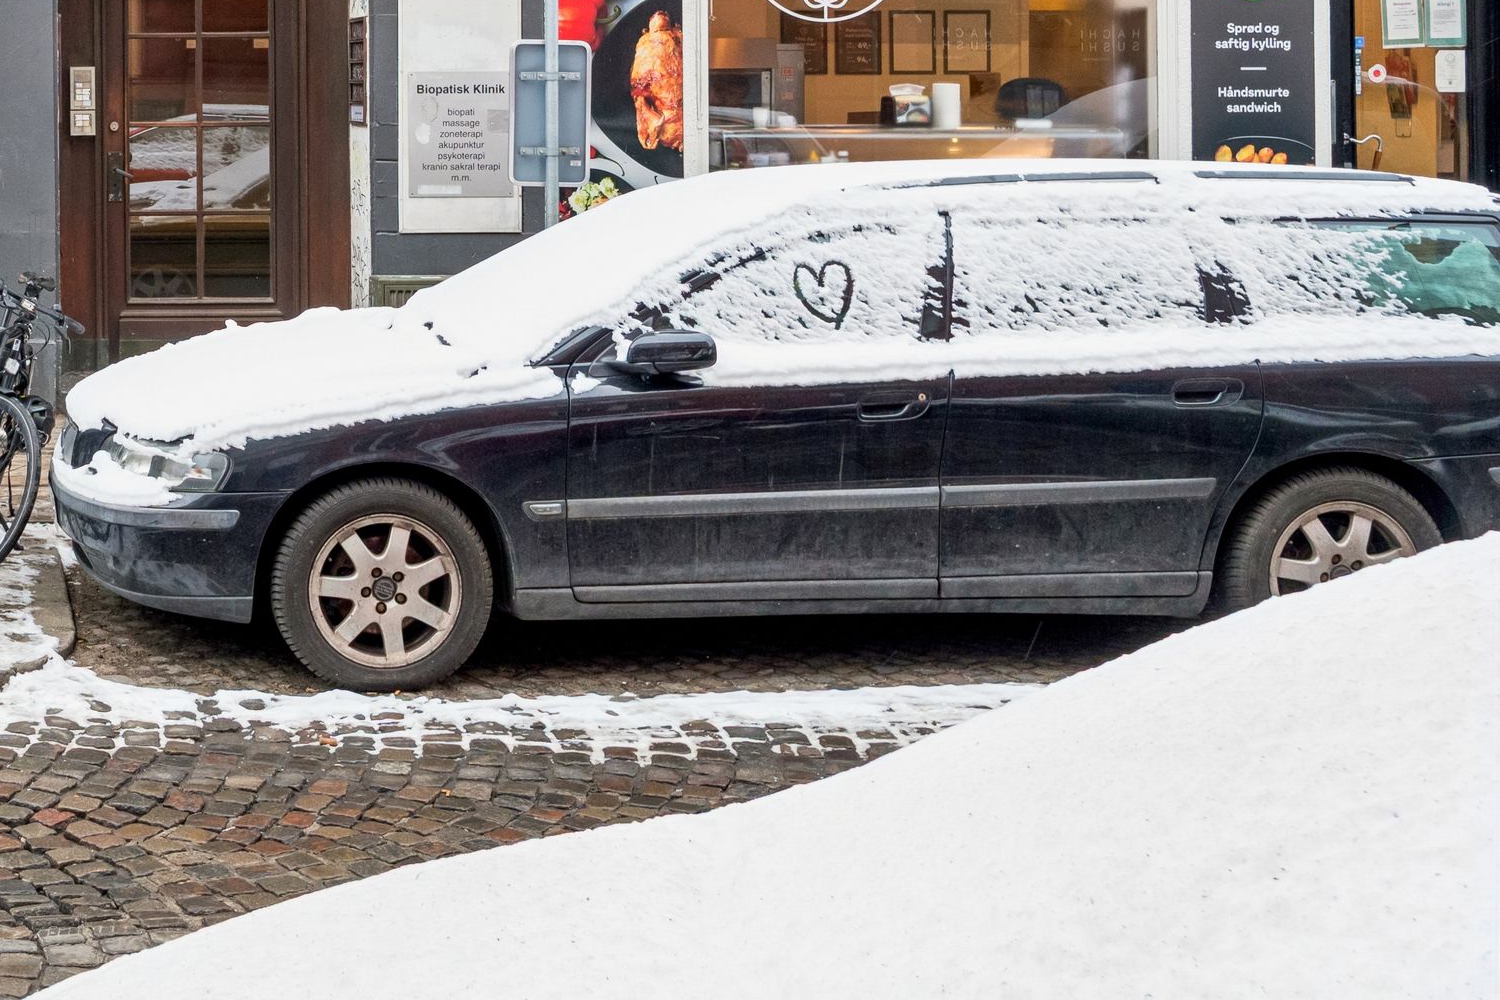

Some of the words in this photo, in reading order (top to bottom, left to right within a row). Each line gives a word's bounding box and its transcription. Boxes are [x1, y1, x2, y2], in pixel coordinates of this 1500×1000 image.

[1226, 22, 1262, 36] Sprød
[1264, 25, 1280, 36] og
[1215, 38, 1250, 51] saftig
[1251, 37, 1292, 51] kylling
[416, 84, 470, 96] Biopatisk
[473, 84, 506, 95] Klinik
[1217, 86, 1290, 98] Håndsmurte
[1226, 101, 1281, 113] sandwich
[447, 108, 475, 118] biopati
[442, 120, 480, 129] massage
[440, 130, 483, 139] zoneterapi
[438, 141, 485, 150] akupunktur
[437, 152, 485, 162] psykoterapi
[422, 163, 448, 171] kranio
[450, 163, 475, 171] sakral
[477, 163, 501, 172] terapi
[451, 174, 472, 182] m.m.
